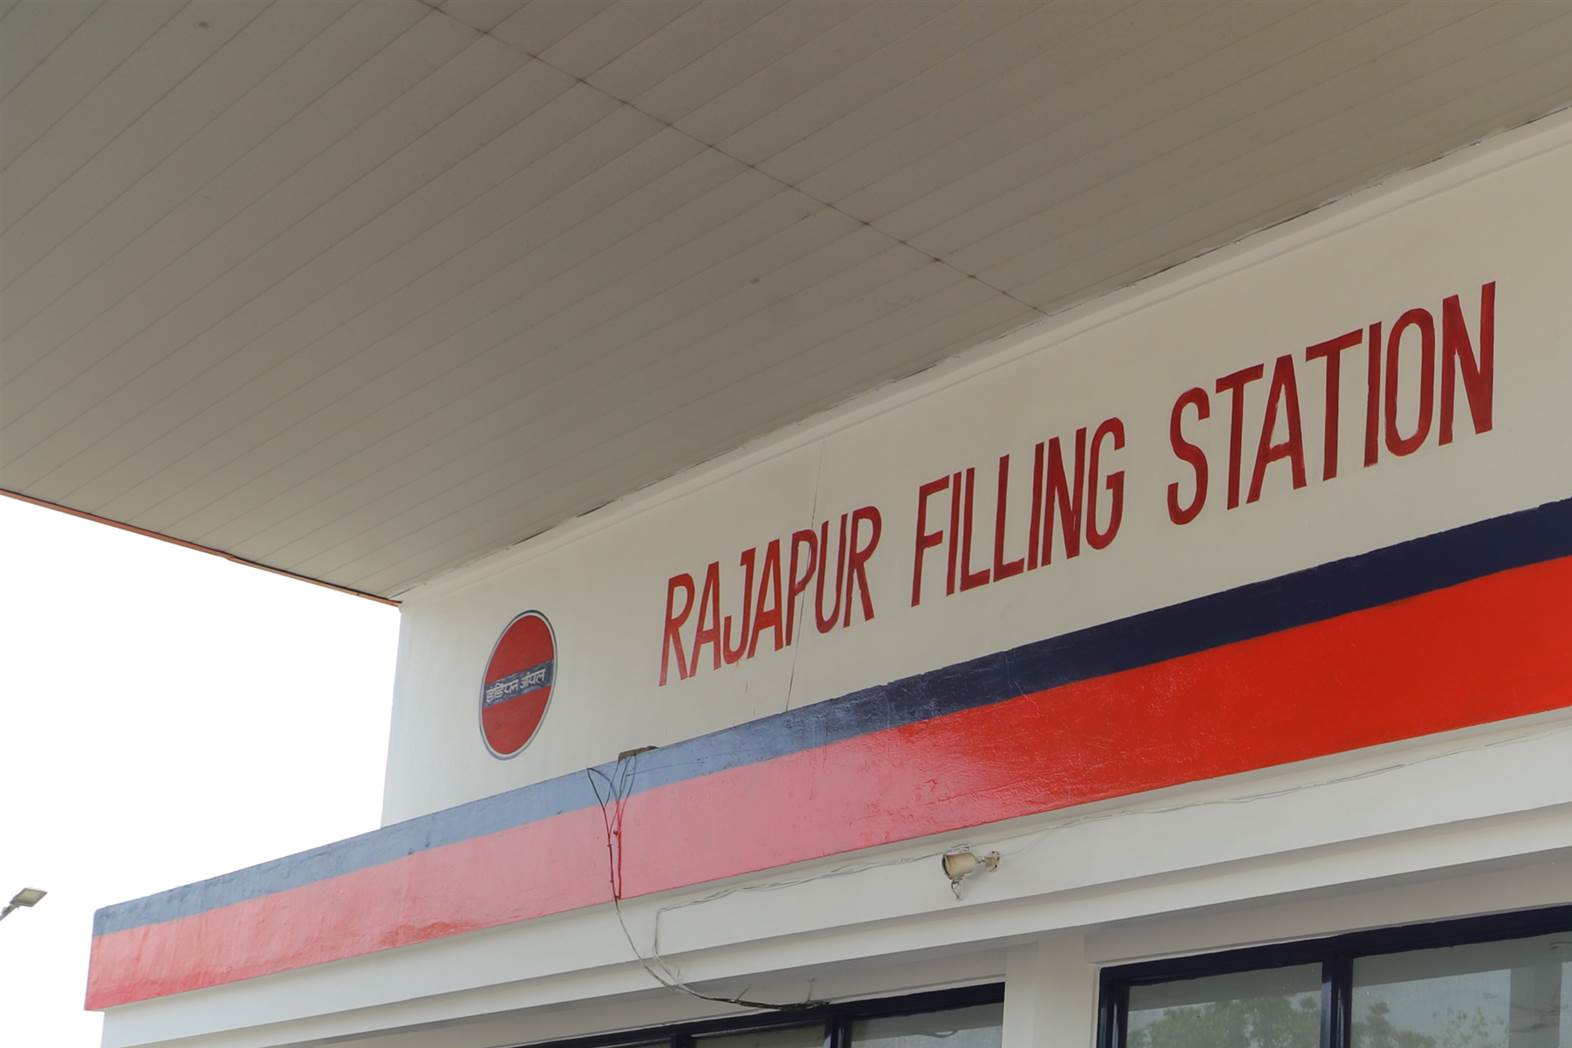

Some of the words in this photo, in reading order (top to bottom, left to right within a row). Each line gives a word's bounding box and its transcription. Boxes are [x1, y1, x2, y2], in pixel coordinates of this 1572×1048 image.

[659, 505, 882, 687] RAJAPUR
[910, 417, 1126, 607] FILLING
[1166, 281, 1496, 526] STATION
